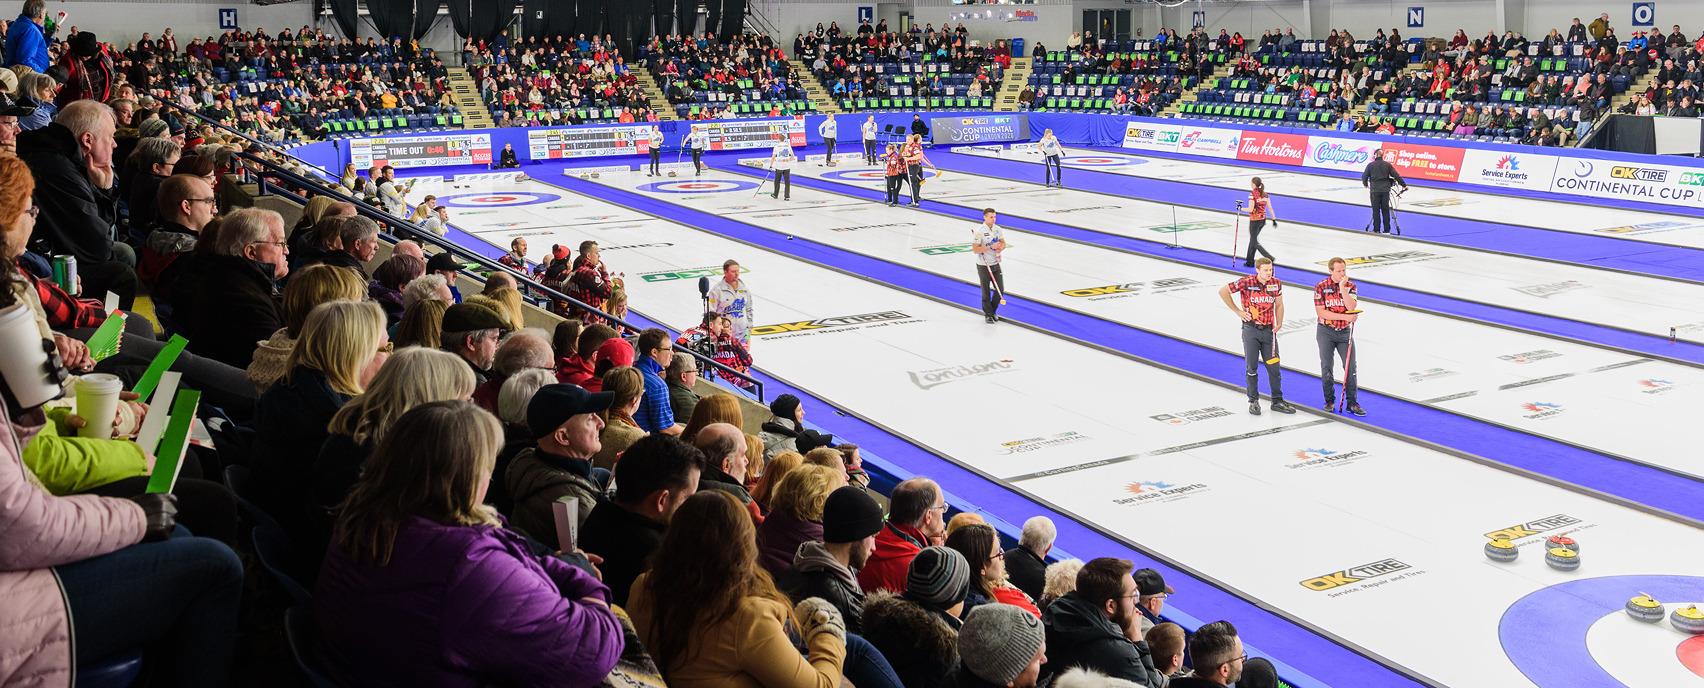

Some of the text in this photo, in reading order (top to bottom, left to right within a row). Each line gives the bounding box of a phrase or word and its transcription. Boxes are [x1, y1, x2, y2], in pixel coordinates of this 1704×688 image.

[222, 11, 235, 27] H
[1410, 10, 1422, 25] N
[962, 125, 1014, 135] CONTINENTAL
[389, 148, 408, 156] TIME
[409, 146, 424, 155] OUT
[1242, 137, 1264, 152] Tim
[1313, 141, 1369, 163] Cashmere
[1399, 149, 1438, 161] Shop online.
[1396, 158, 1411, 169] Ship
[1411, 159, 1429, 168] FREE
[1437, 163, 1456, 172] store.
[1481, 168, 1528, 181] Service Experts
[1611, 165, 1666, 182] OK TIRE
[1556, 177, 1656, 198] CONTINENTAL
[1659, 187, 1695, 201] CUP
[751, 310, 903, 336] OK TIRE
[1186, 410, 1236, 422] CANADA
[1112, 490, 1162, 506] Service
[1161, 481, 1208, 497] Experts
[1299, 558, 1405, 592] OK TIRE
